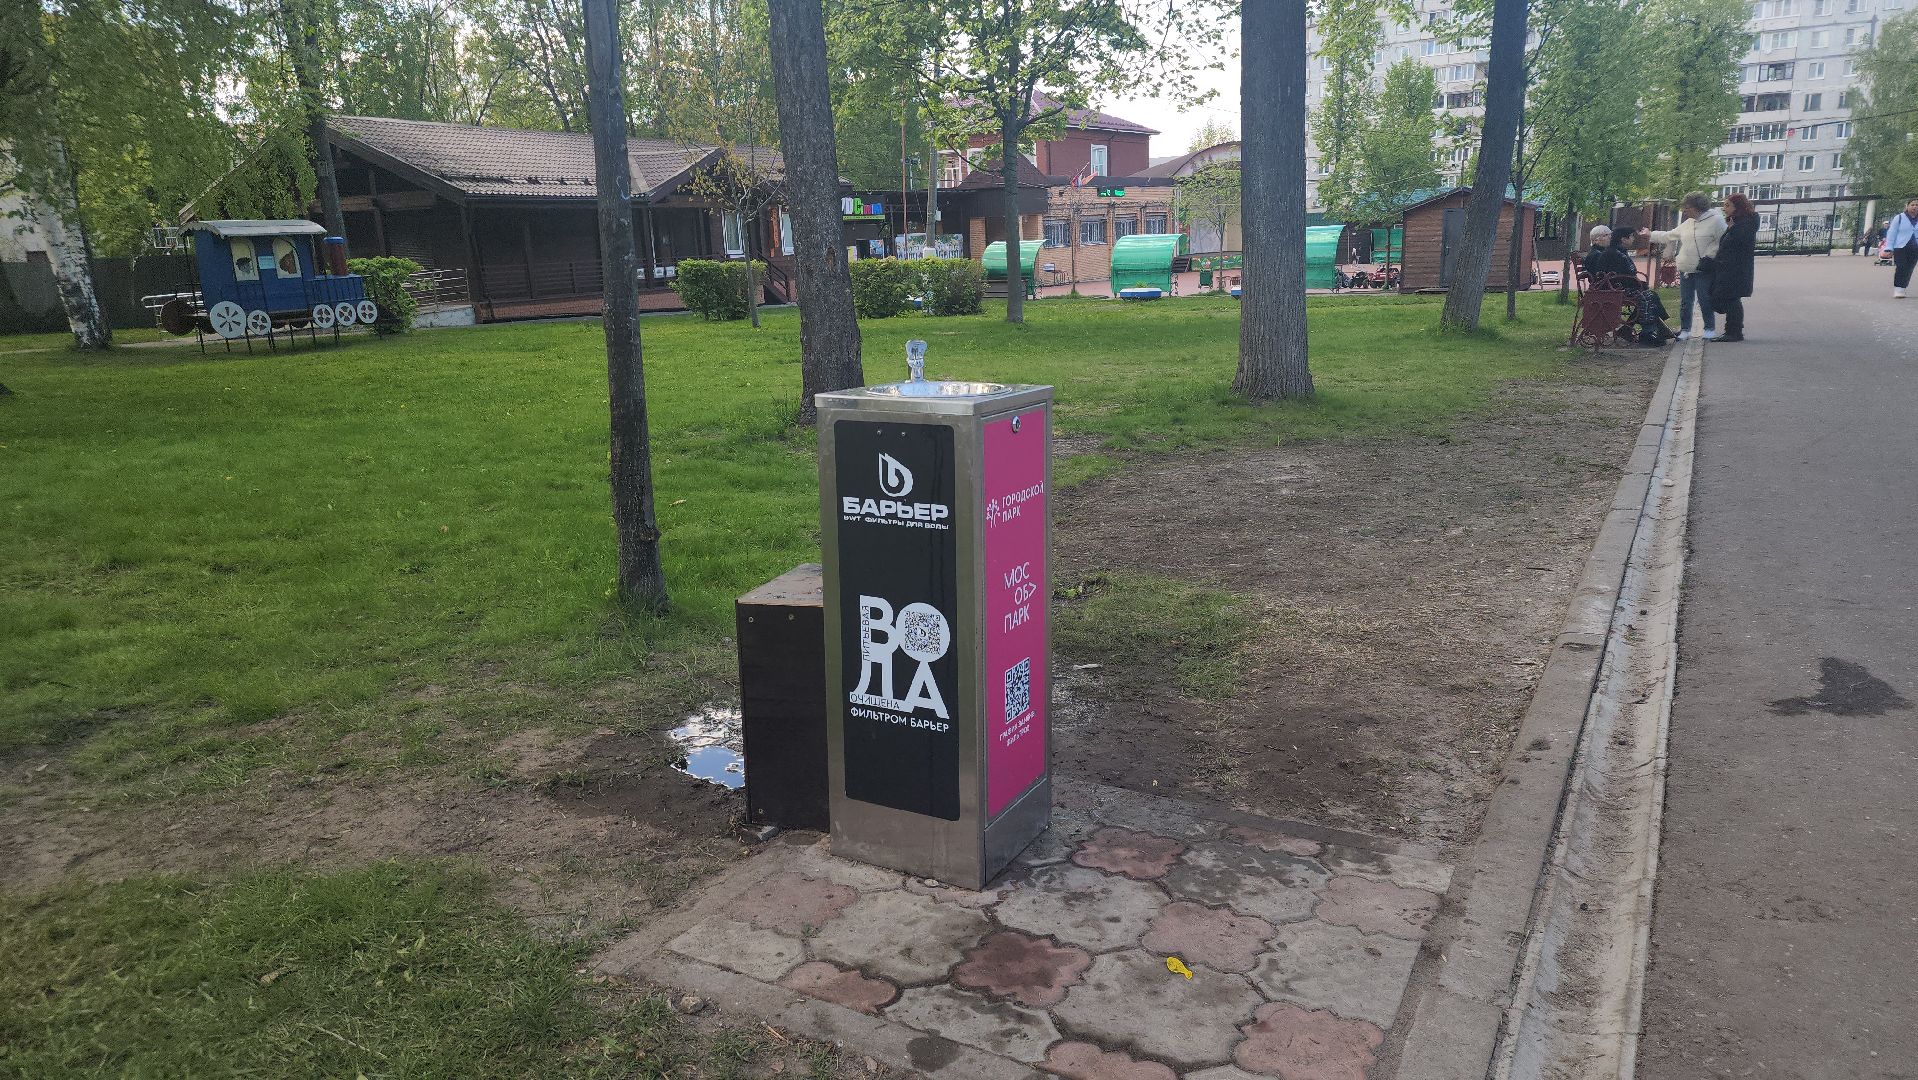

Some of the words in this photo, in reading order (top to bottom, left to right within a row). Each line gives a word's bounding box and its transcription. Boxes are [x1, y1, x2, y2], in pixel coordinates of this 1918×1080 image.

[1002, 481, 1044, 509] ГОРОДСКОЙ
[843, 497, 948, 521] БАРЬЕР
[865, 517, 904, 526] ФИЛЬТРЫ
[906, 520, 923, 528] ДЛЯ
[1002, 505, 1021, 523] ПАРК
[1004, 561, 1030, 590] МОС
[1004, 603, 1030, 634] ПАРК
[862, 605, 871, 662] ПИТЬЕВАЯ
[850, 693, 900, 710] ОЧИЩЕНА
[850, 706, 907, 726] ФИЛЬТРОМ
[910, 717, 949, 733] БАРЬЕР
